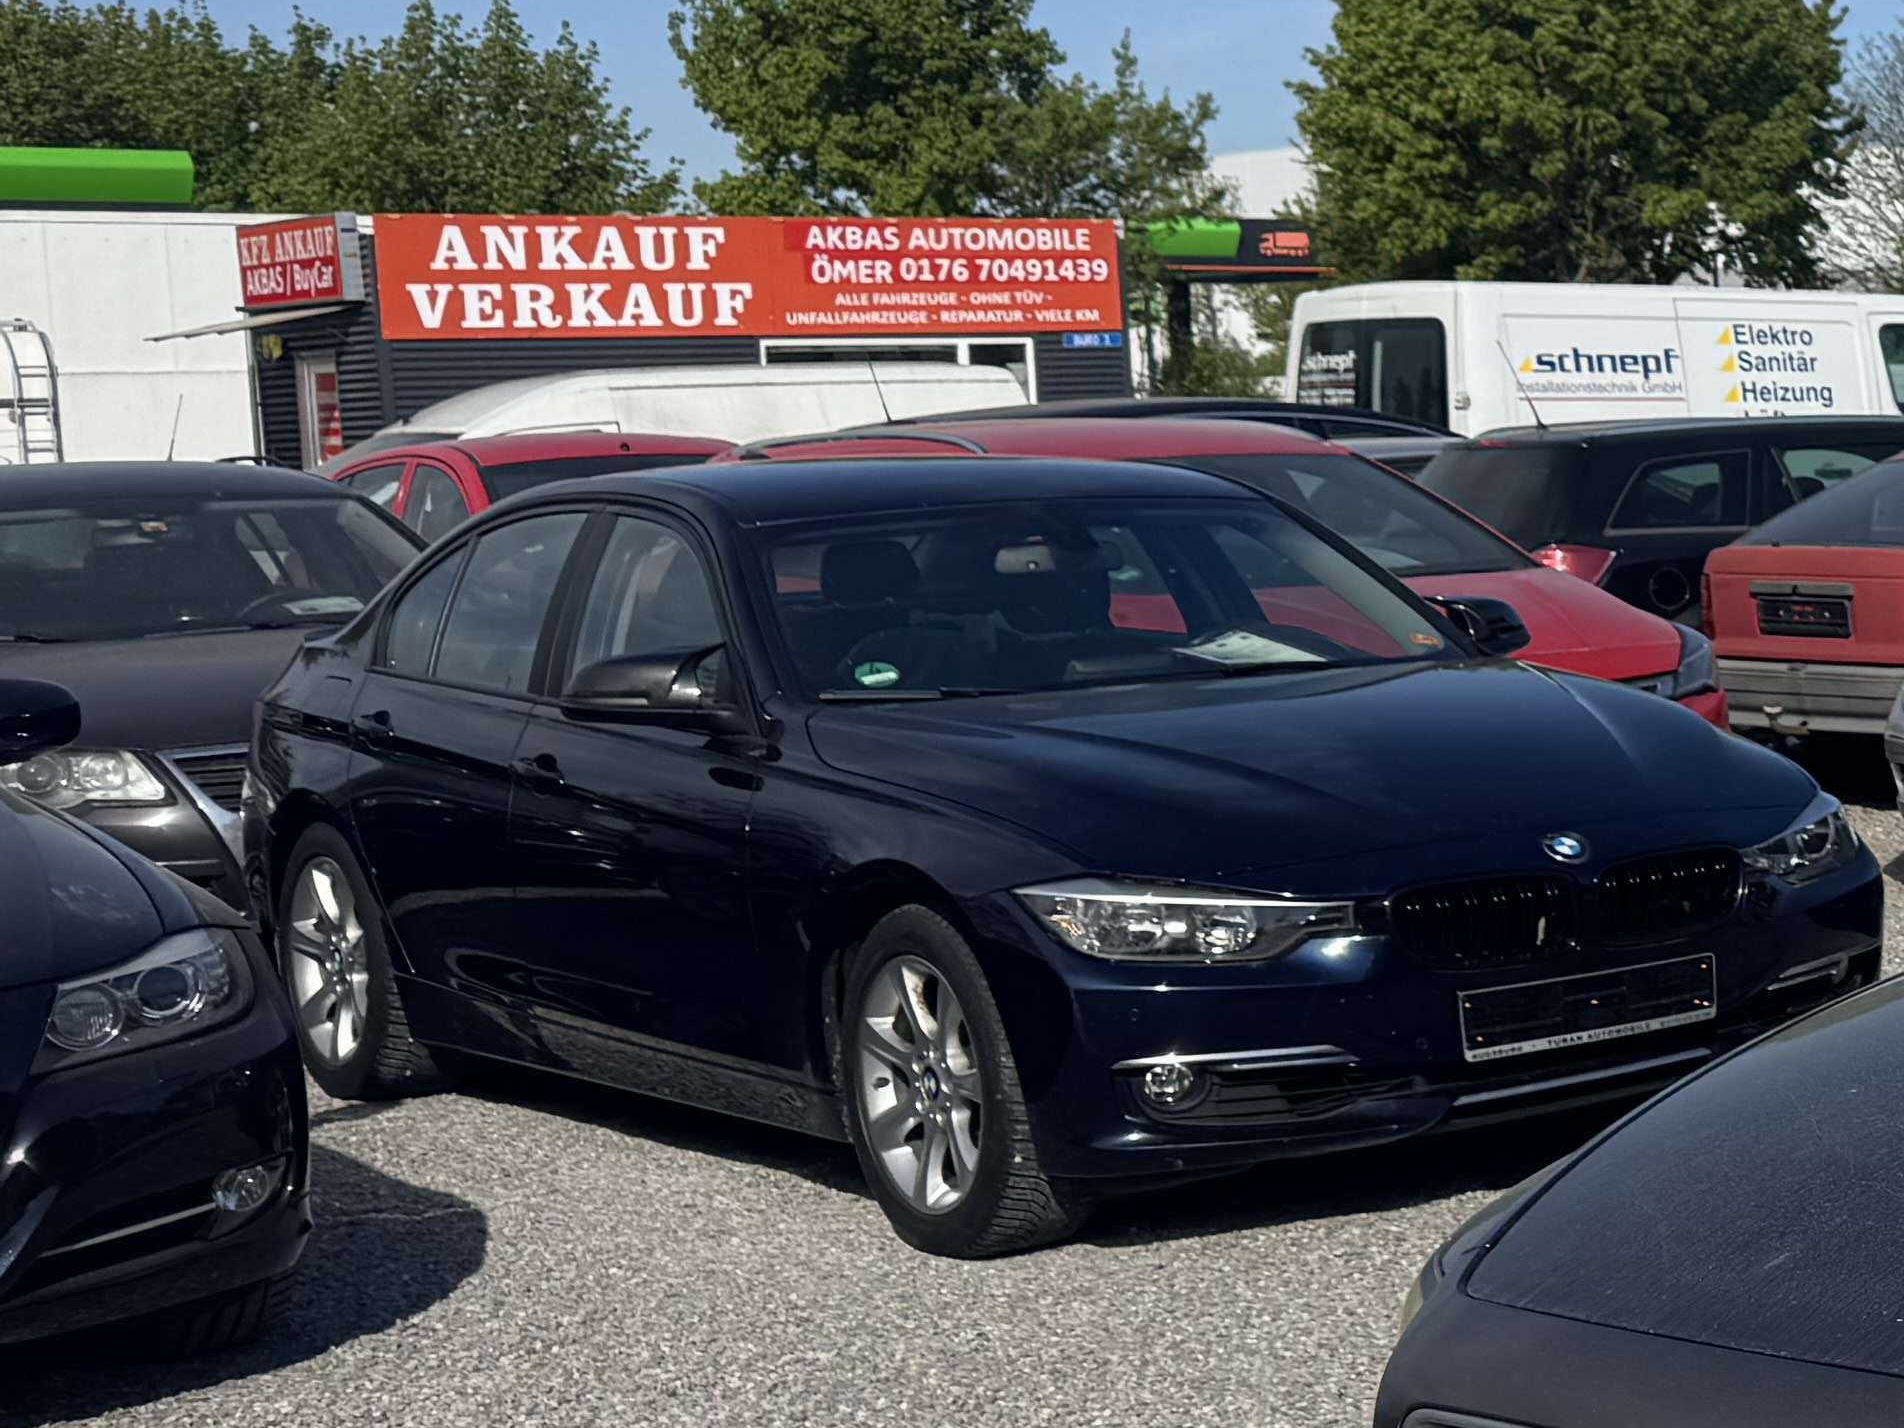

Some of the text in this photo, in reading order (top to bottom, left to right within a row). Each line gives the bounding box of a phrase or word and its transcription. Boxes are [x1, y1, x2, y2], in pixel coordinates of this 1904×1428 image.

[240, 225, 334, 266] KFZ ANKAUF
[430, 225, 725, 271] ANKAUF
[805, 225, 1091, 251] AKBAS AUTOMOBILE
[811, 254, 1109, 284] ÖMER 0176 70491439
[405, 283, 752, 329] VERKAUF
[835, 292, 869, 306] ALLE
[873, 292, 957, 306] FAHRZEUGE
[970, 291, 1011, 306] OHNE
[1014, 289, 1044, 306] TÜV
[786, 310, 929, 325] UNFALLFAHRZEUGE
[940, 309, 1023, 324] REPARATUR
[1035, 309, 1073, 322] VIELE
[1075, 308, 1100, 322] KM
[1733, 324, 1813, 346] Elektro
[1535, 347, 1681, 380] schnepf
[1737, 350, 1817, 372] Sanitär
[1641, 381, 1682, 395] GmbH
[1741, 380, 1834, 408] Heizung
